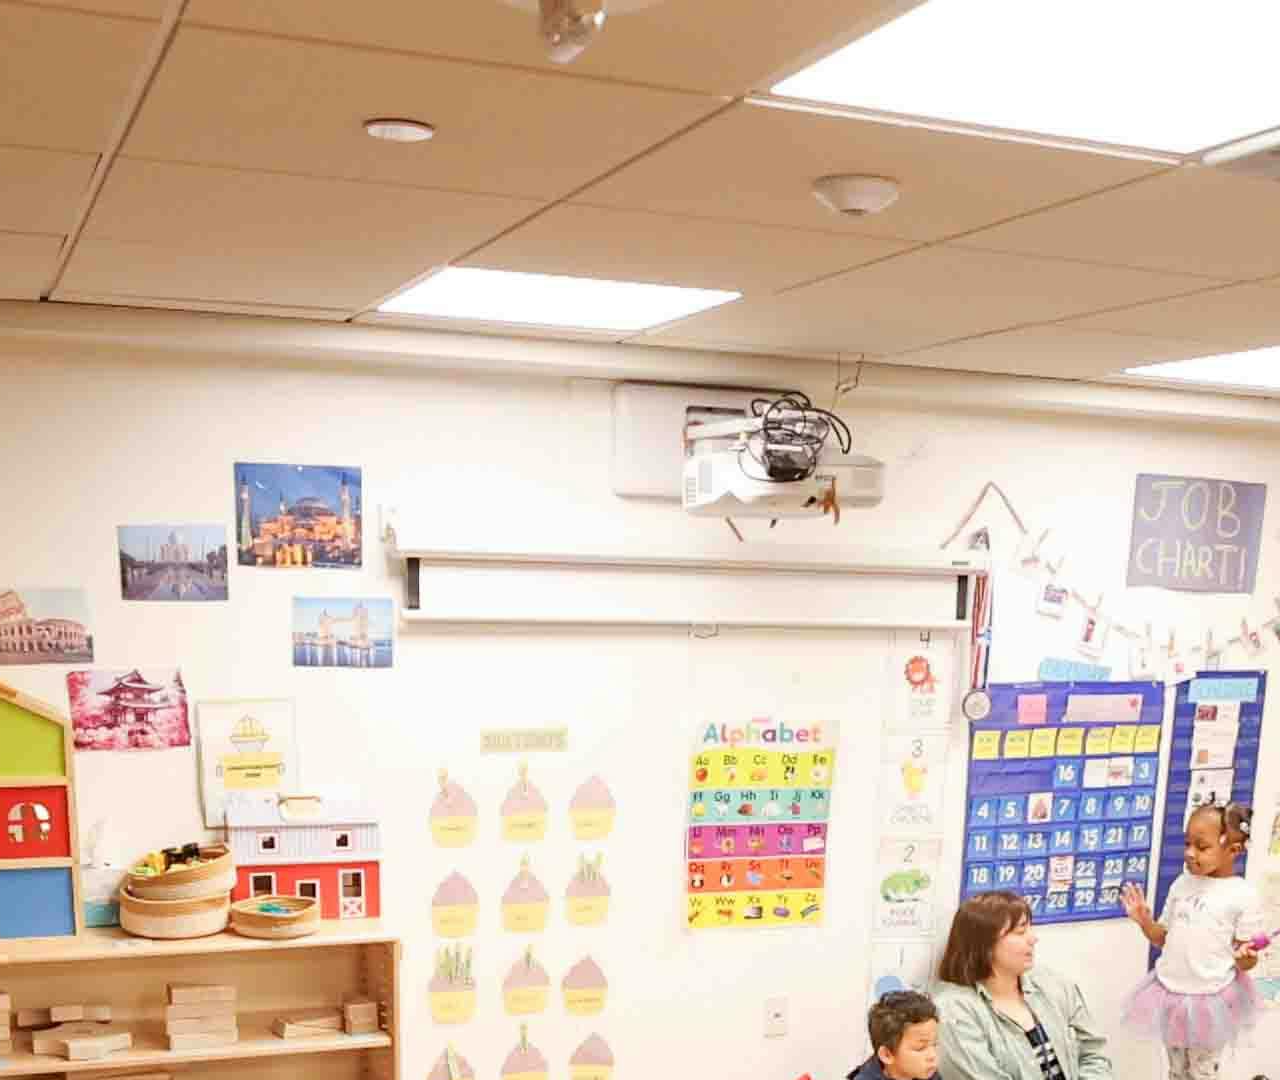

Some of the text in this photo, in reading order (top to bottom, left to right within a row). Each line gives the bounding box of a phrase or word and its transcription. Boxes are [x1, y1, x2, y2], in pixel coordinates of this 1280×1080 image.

[1139, 481, 1240, 537] JOB
[1136, 538, 1248, 591] CHART!
[703, 721, 822, 748] Alphabet
[1058, 762, 1150, 781] 16 3
[977, 795, 1151, 819] 4 5 7 8 9 10
[974, 834, 987, 850] 11
[1001, 833, 1017, 849] 12
[1027, 831, 1044, 848] 13
[1055, 830, 1070, 847] 14
[1133, 825, 1147, 841] 17
[903, 845, 916, 863] 2
[972, 867, 987, 883] 18
[1000, 866, 1015, 882] 19
[1024, 867, 1045, 883] 20
[1076, 862, 1095, 877] 22
[1104, 859, 1123, 875] 23
[1127, 857, 1147, 873] 24
[1048, 892, 1067, 909] 28
[1075, 889, 1094, 906] 29
